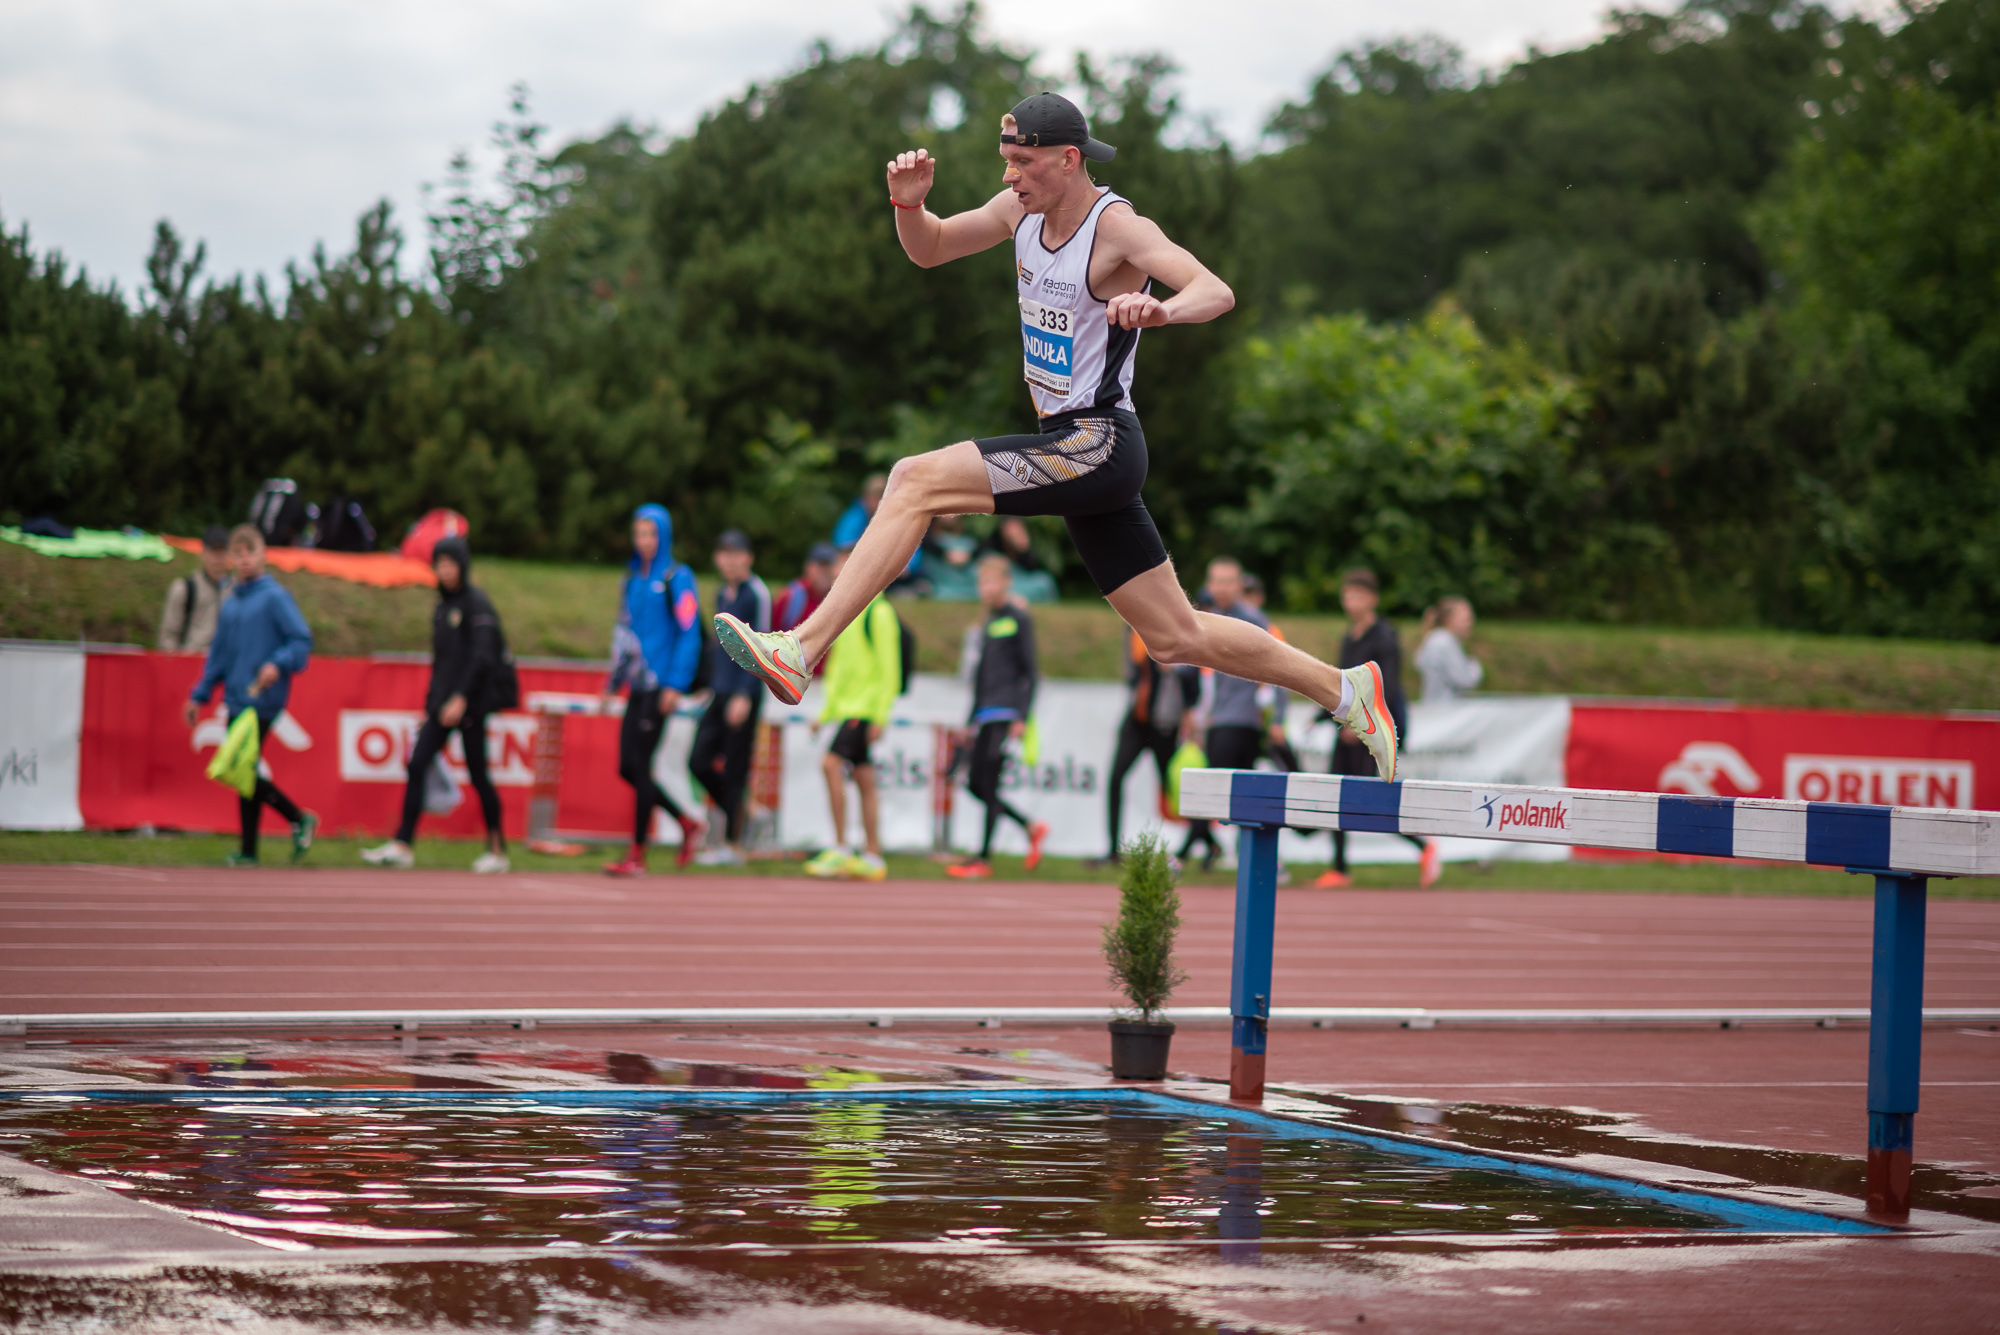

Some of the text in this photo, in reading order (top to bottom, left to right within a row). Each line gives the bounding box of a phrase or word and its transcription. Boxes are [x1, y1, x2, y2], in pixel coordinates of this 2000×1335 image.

[1039, 308, 1068, 332] 333
[1798, 770, 1959, 808] ORLEN
[1498, 798, 1568, 832] polanik
